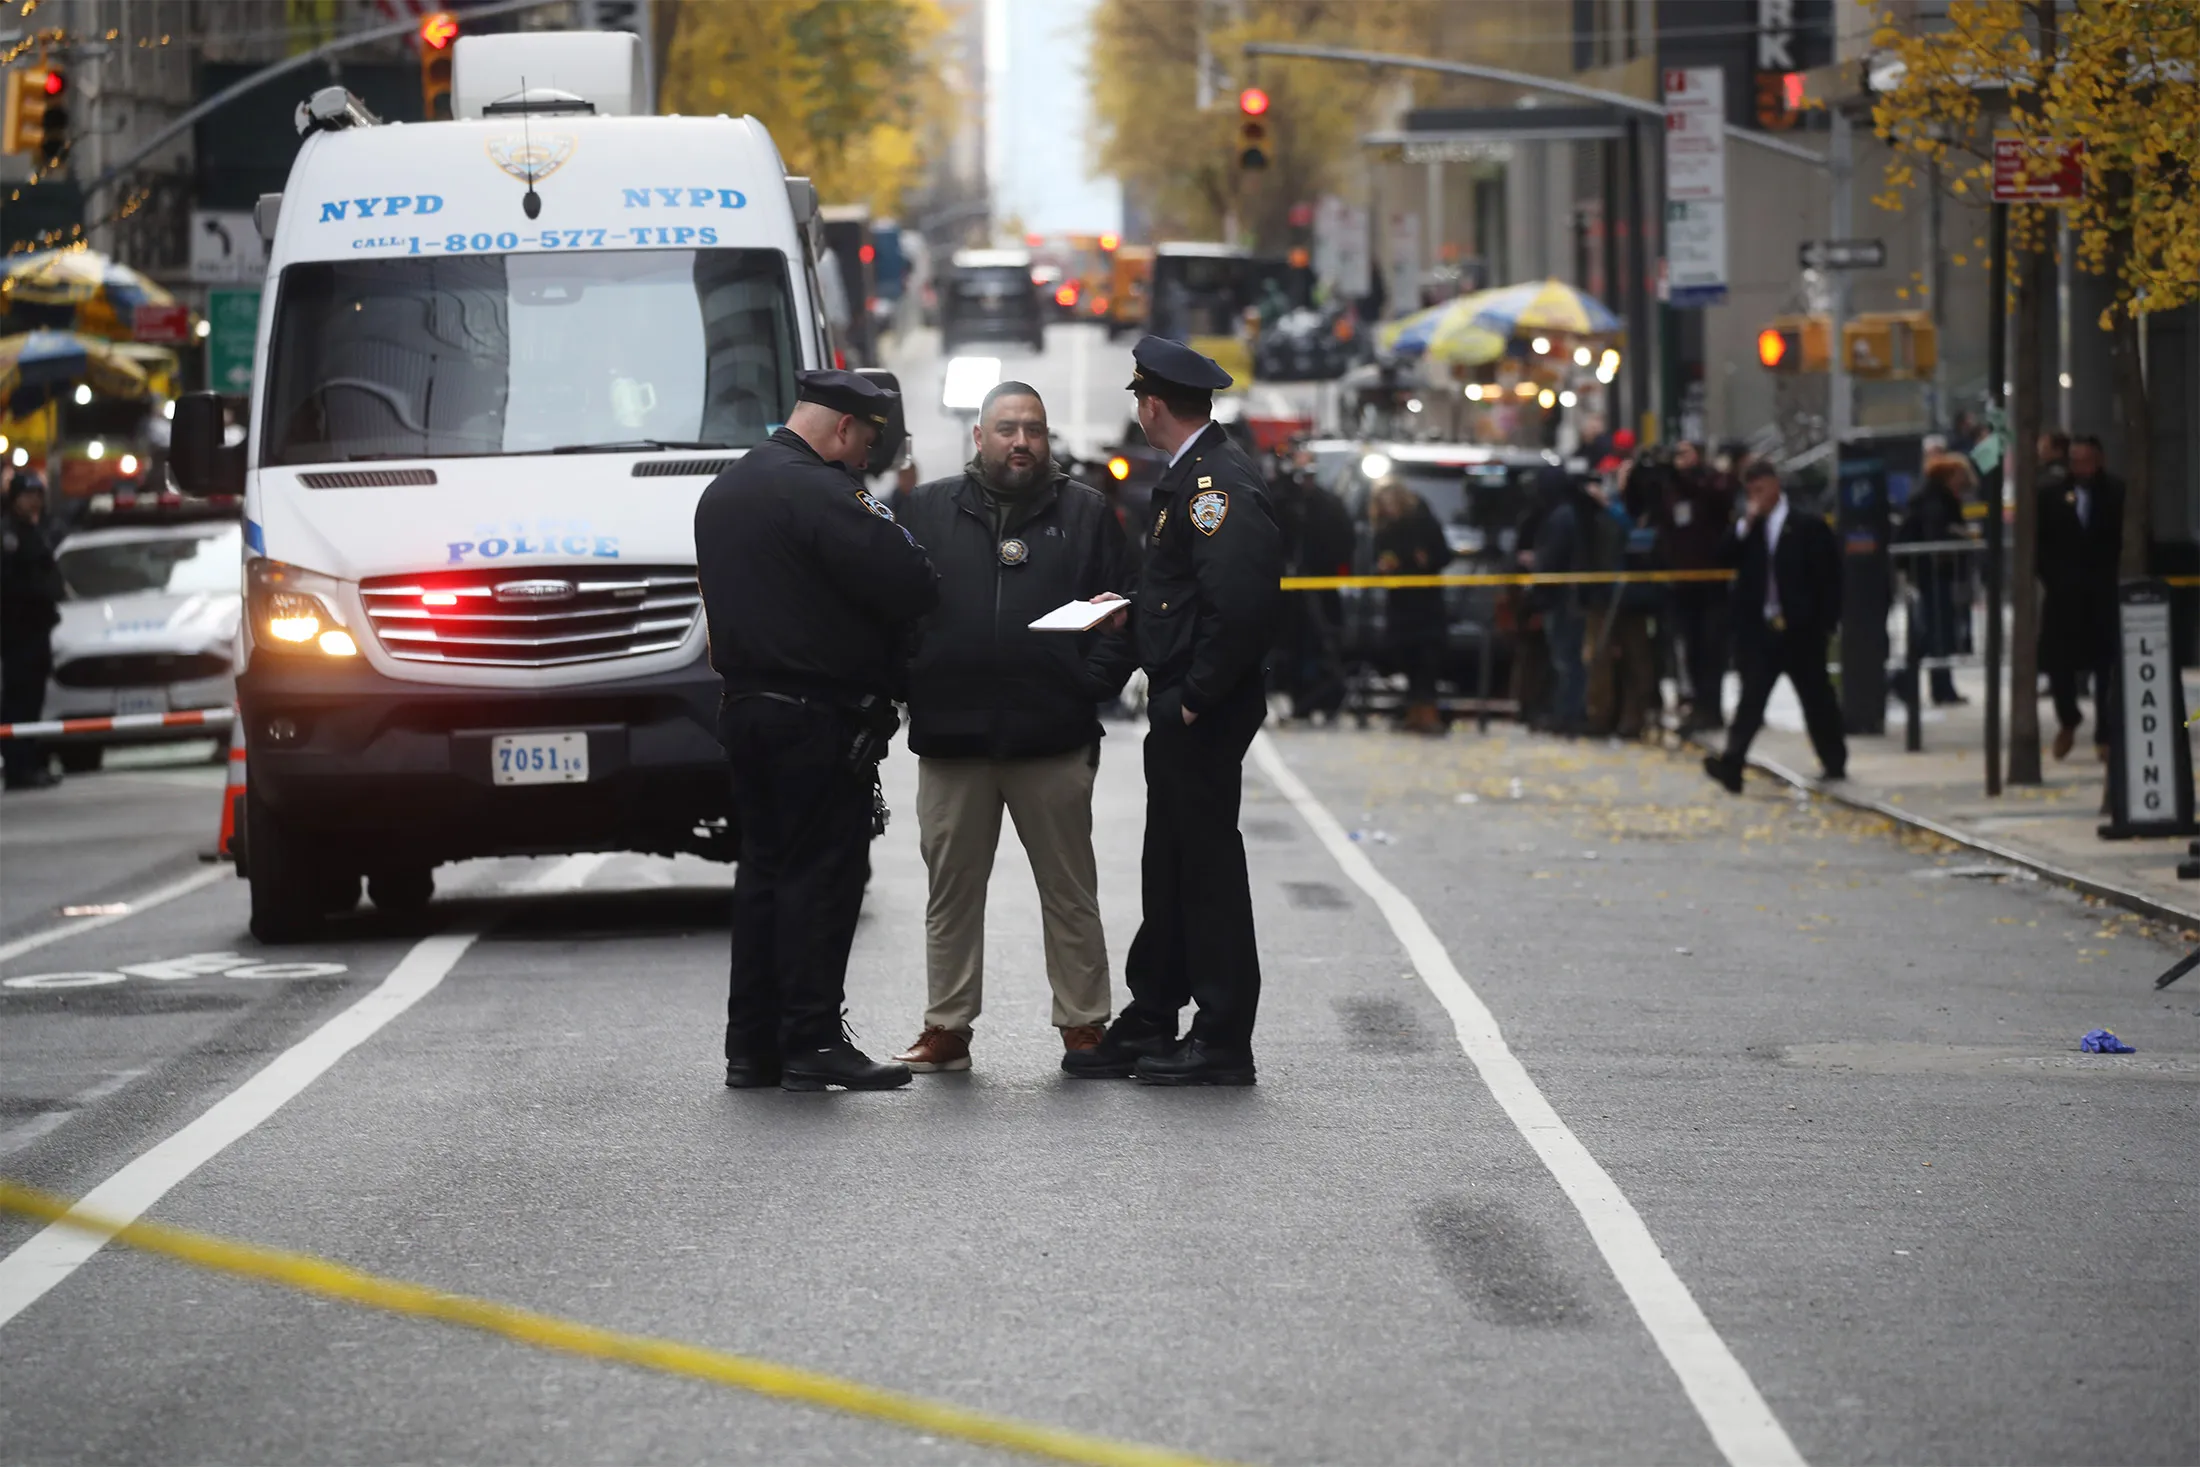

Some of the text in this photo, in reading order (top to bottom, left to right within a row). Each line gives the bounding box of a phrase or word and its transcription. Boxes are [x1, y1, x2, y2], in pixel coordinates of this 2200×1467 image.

[319, 195, 444, 223] NYPD
[621, 187, 748, 209] NYPD
[408, 226, 719, 254] 1-800-577-TIPS
[446, 534, 620, 565] POLICE
[2139, 637, 2161, 810] LOADING
[499, 746, 558, 772] 7051
